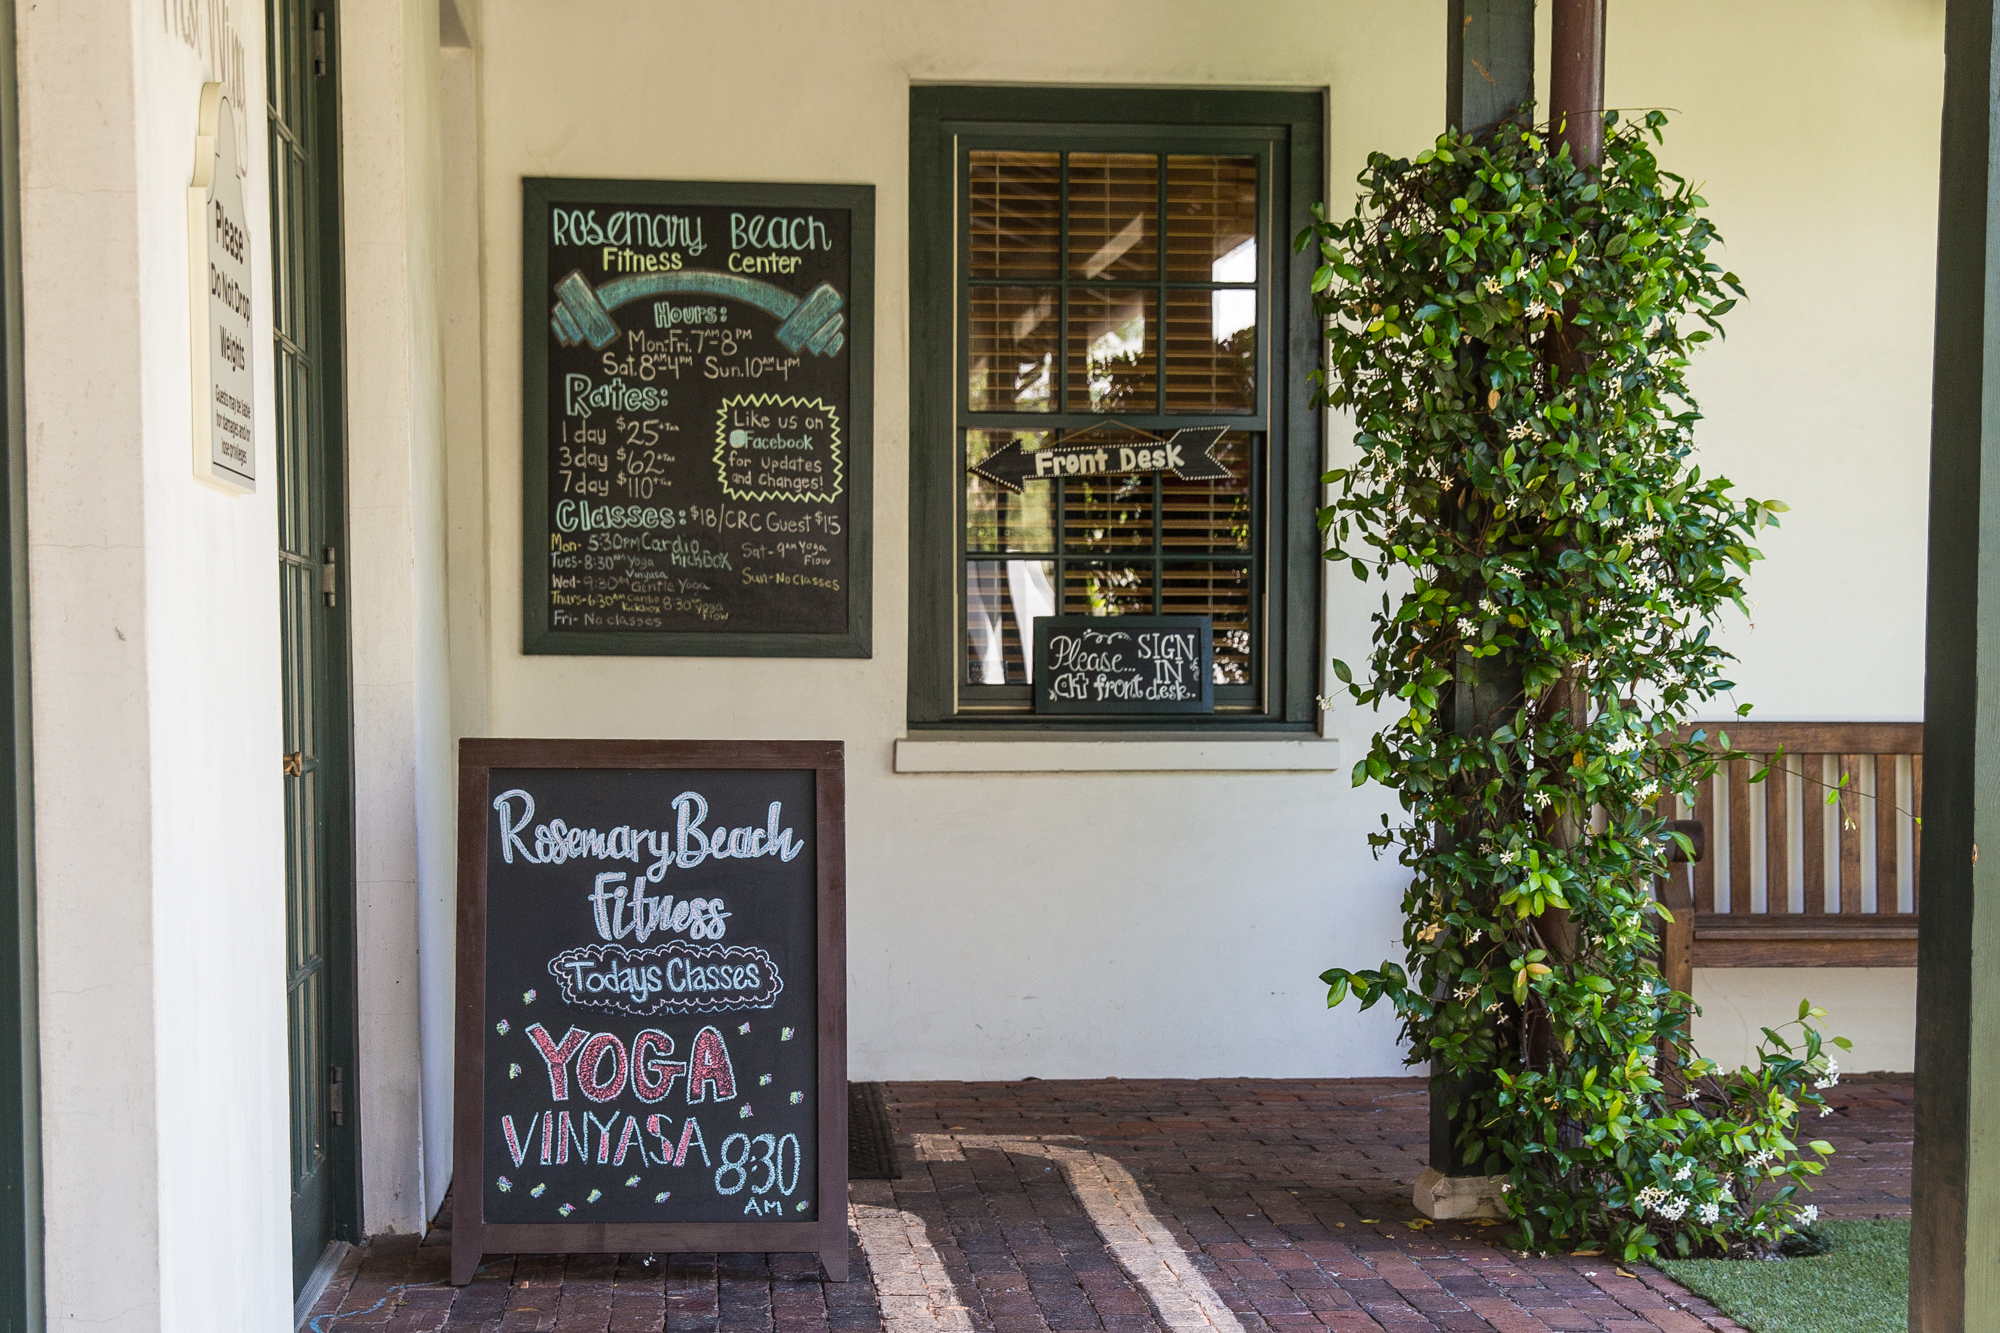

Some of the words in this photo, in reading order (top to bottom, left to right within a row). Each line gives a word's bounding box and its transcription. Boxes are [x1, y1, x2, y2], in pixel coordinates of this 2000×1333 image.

[215, 199, 244, 265] Please
[553, 208, 707, 256] Rosemary
[730, 212, 832, 251] Beach
[603, 247, 682, 273] Fitness
[728, 250, 802, 274] Center
[211, 262, 221, 299] Do
[222, 271, 234, 310] Not
[234, 281, 250, 328] Drop
[653, 300, 727, 328] Hours:
[220, 324, 245, 373] Weights
[602, 351, 637, 377] Sat.
[703, 355, 744, 379] Sun.
[565, 373, 668, 419] Rates:
[563, 420, 567, 443] 1
[574, 419, 606, 445] day
[616, 414, 660, 447] $25
[734, 409, 771, 428] Like
[778, 415, 798, 429] us
[805, 417, 824, 430] on
[744, 429, 814, 451] Facebook
[559, 446, 573, 467] 3
[574, 445, 608, 472] day
[616, 446, 665, 475] $62
[728, 449, 752, 467] for
[761, 455, 822, 473] Updates
[1034, 450, 1109, 477] Front
[1119, 443, 1185, 471] Desk
[559, 470, 572, 493] 7
[574, 472, 609, 497] day
[616, 469, 654, 499] $110
[731, 470, 752, 486] and
[758, 472, 824, 493] Changes!
[556, 499, 687, 532] Classes:
[766, 511, 812, 533] Guest
[814, 510, 841, 535] $15
[641, 531, 699, 554] Cardio
[799, 540, 827, 556] Yoga
[804, 554, 831, 566] Flow
[631, 580, 675, 593] Gentle
[678, 578, 711, 596] Yoga
[776, 572, 791, 585] No
[584, 612, 603, 626] No
[1138, 632, 1195, 660] SIGN
[1154, 659, 1184, 684] IN
[1093, 673, 1143, 701] front
[493, 789, 675, 883] Rosemary
[671, 791, 804, 869] Beach
[587, 871, 732, 943] Fitness
[561, 958, 664, 1003] Todays
[665, 957, 763, 993] Classes
[524, 1022, 737, 1105] YOGA
[501, 1108, 712, 1169] VINYASA
[743, 1196, 783, 1216] AM
